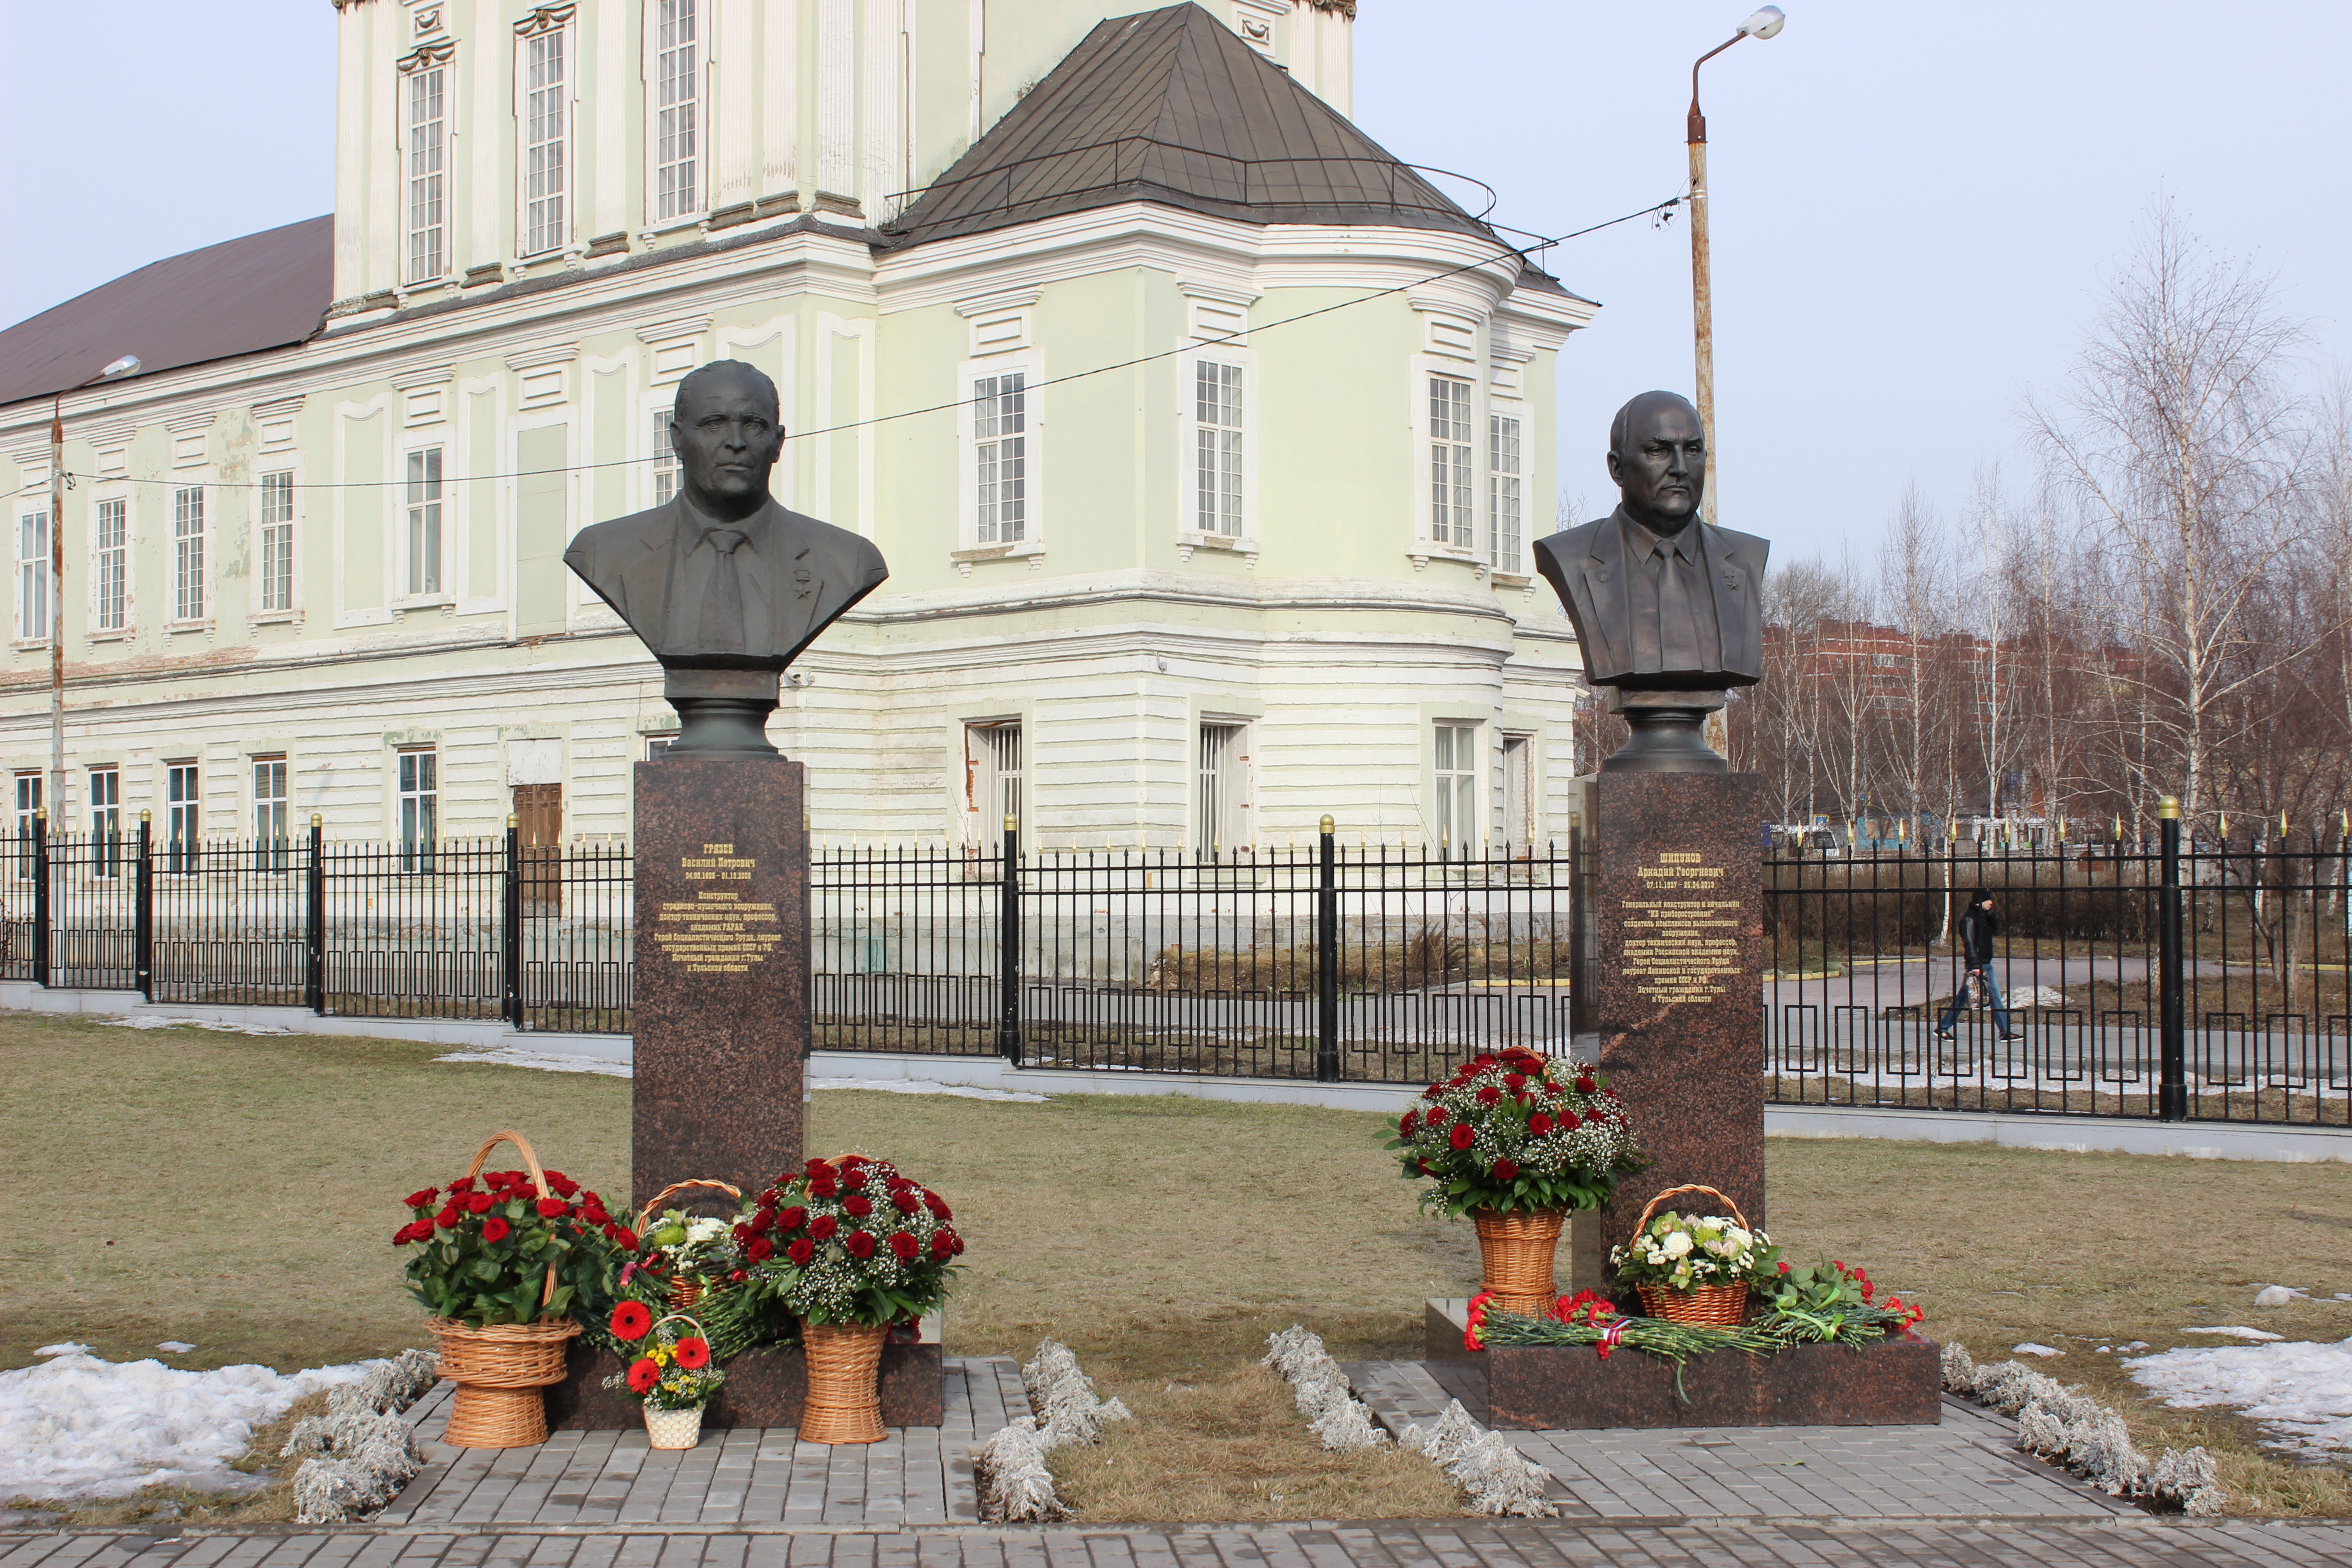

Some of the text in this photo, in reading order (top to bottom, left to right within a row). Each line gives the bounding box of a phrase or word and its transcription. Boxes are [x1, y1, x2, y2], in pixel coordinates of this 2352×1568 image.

[704, 844, 733, 854] ГРЯЗЕВ
[1660, 853, 1701, 863] ШИПУНОВ
[682, 858, 755, 868] Василий Петрович
[1637, 867, 1724, 878] Аркадий Георгиевич
[698, 891, 738, 901] Конструктор
[663, 903, 774, 912] стрелково-пушечного вооружения,
[1622, 900, 1662, 909] Генеральный
[1660, 910, 1714, 918] приборостроения"
[654, 933, 672, 942] Герой
[673, 933, 734, 941] Социалистического
[757, 934, 781, 942] лауреат
[662, 944, 716, 952] государственных
[718, 943, 741, 952] премий
[672, 953, 703, 961] Почетный
[704, 954, 740, 963] гражданин
[1633, 957, 1651, 966] Герой
[1651, 957, 1710, 965] Социалистического
[693, 963, 722, 973] Тульской
[724, 963, 748, 972] области
[1654, 976, 1677, 985] премий
[1698, 975, 1707, 985] РФ
[1637, 985, 1668, 994] Почетный
[1704, 985, 1726, 994] г.Тулы
[1657, 995, 1686, 1004] Тульской
[1687, 995, 1711, 1003] области
